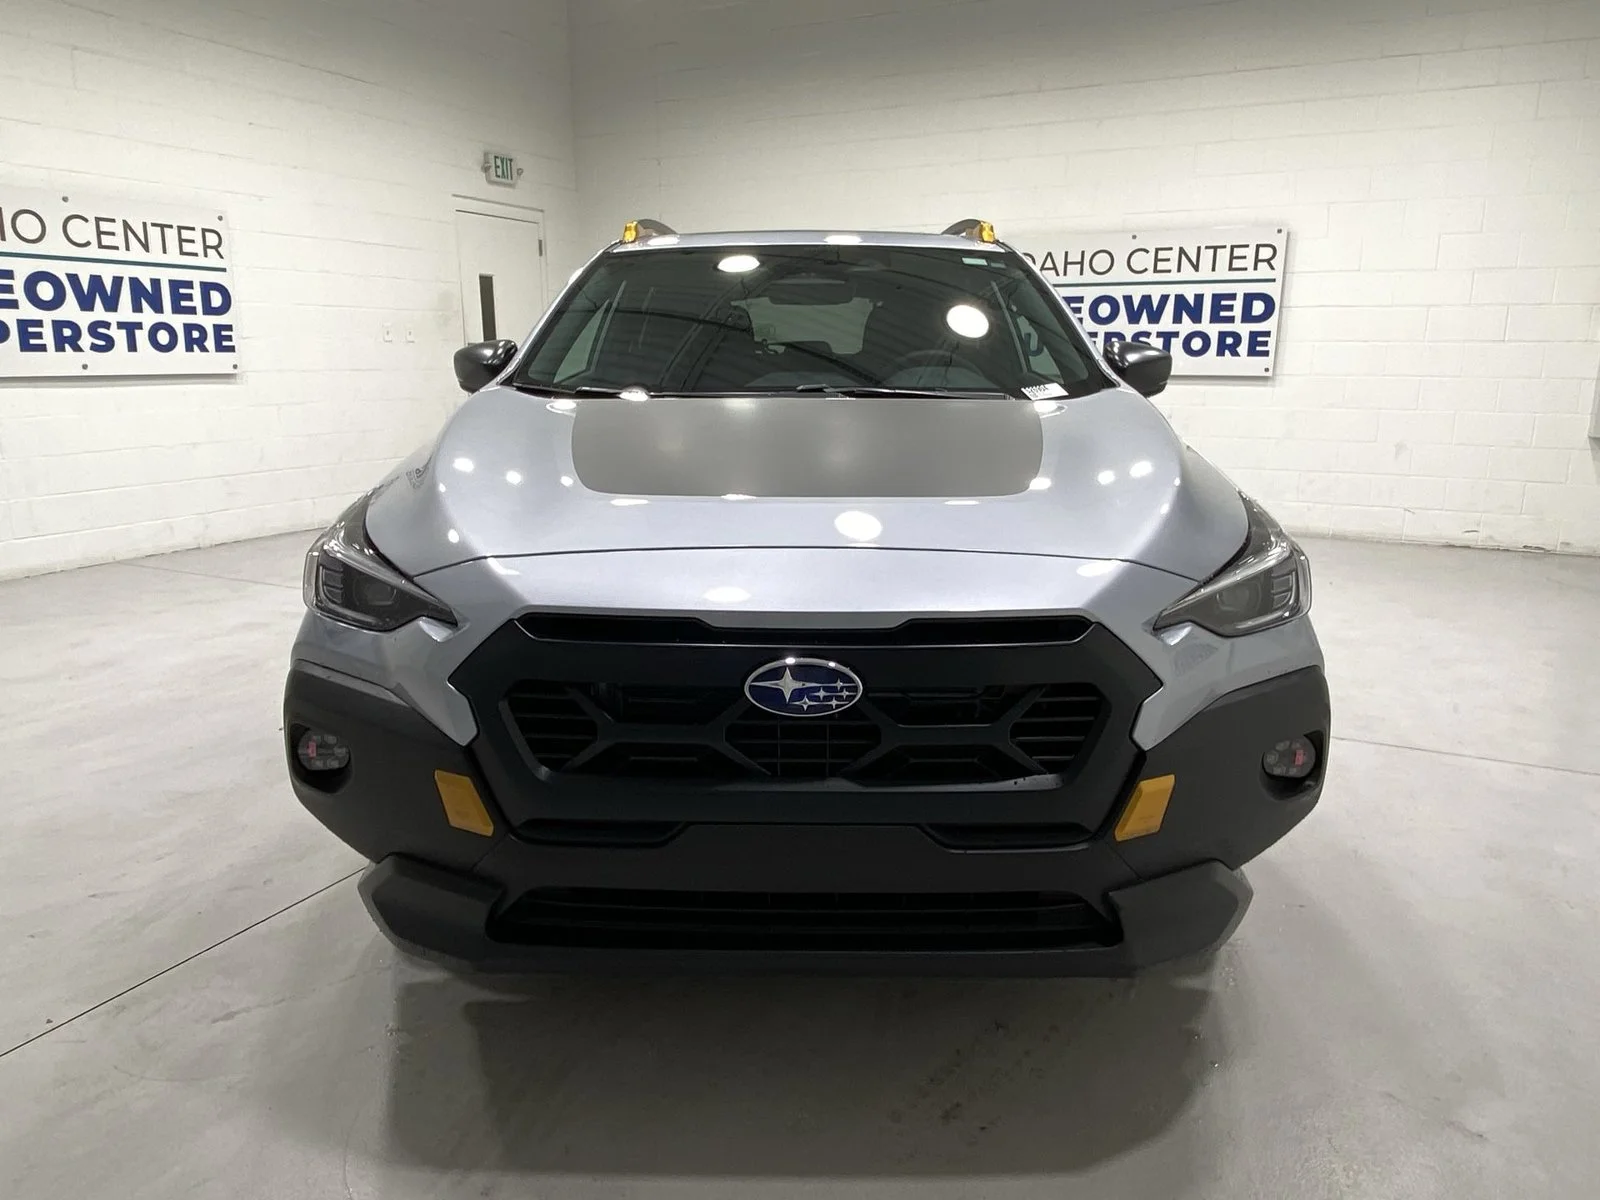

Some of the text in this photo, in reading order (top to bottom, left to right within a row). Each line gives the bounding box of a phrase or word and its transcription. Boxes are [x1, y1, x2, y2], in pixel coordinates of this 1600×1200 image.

[494, 155, 513, 181] EXIT
[0, 206, 225, 260] O CENTER
[1126, 243, 1278, 275] CENTER
